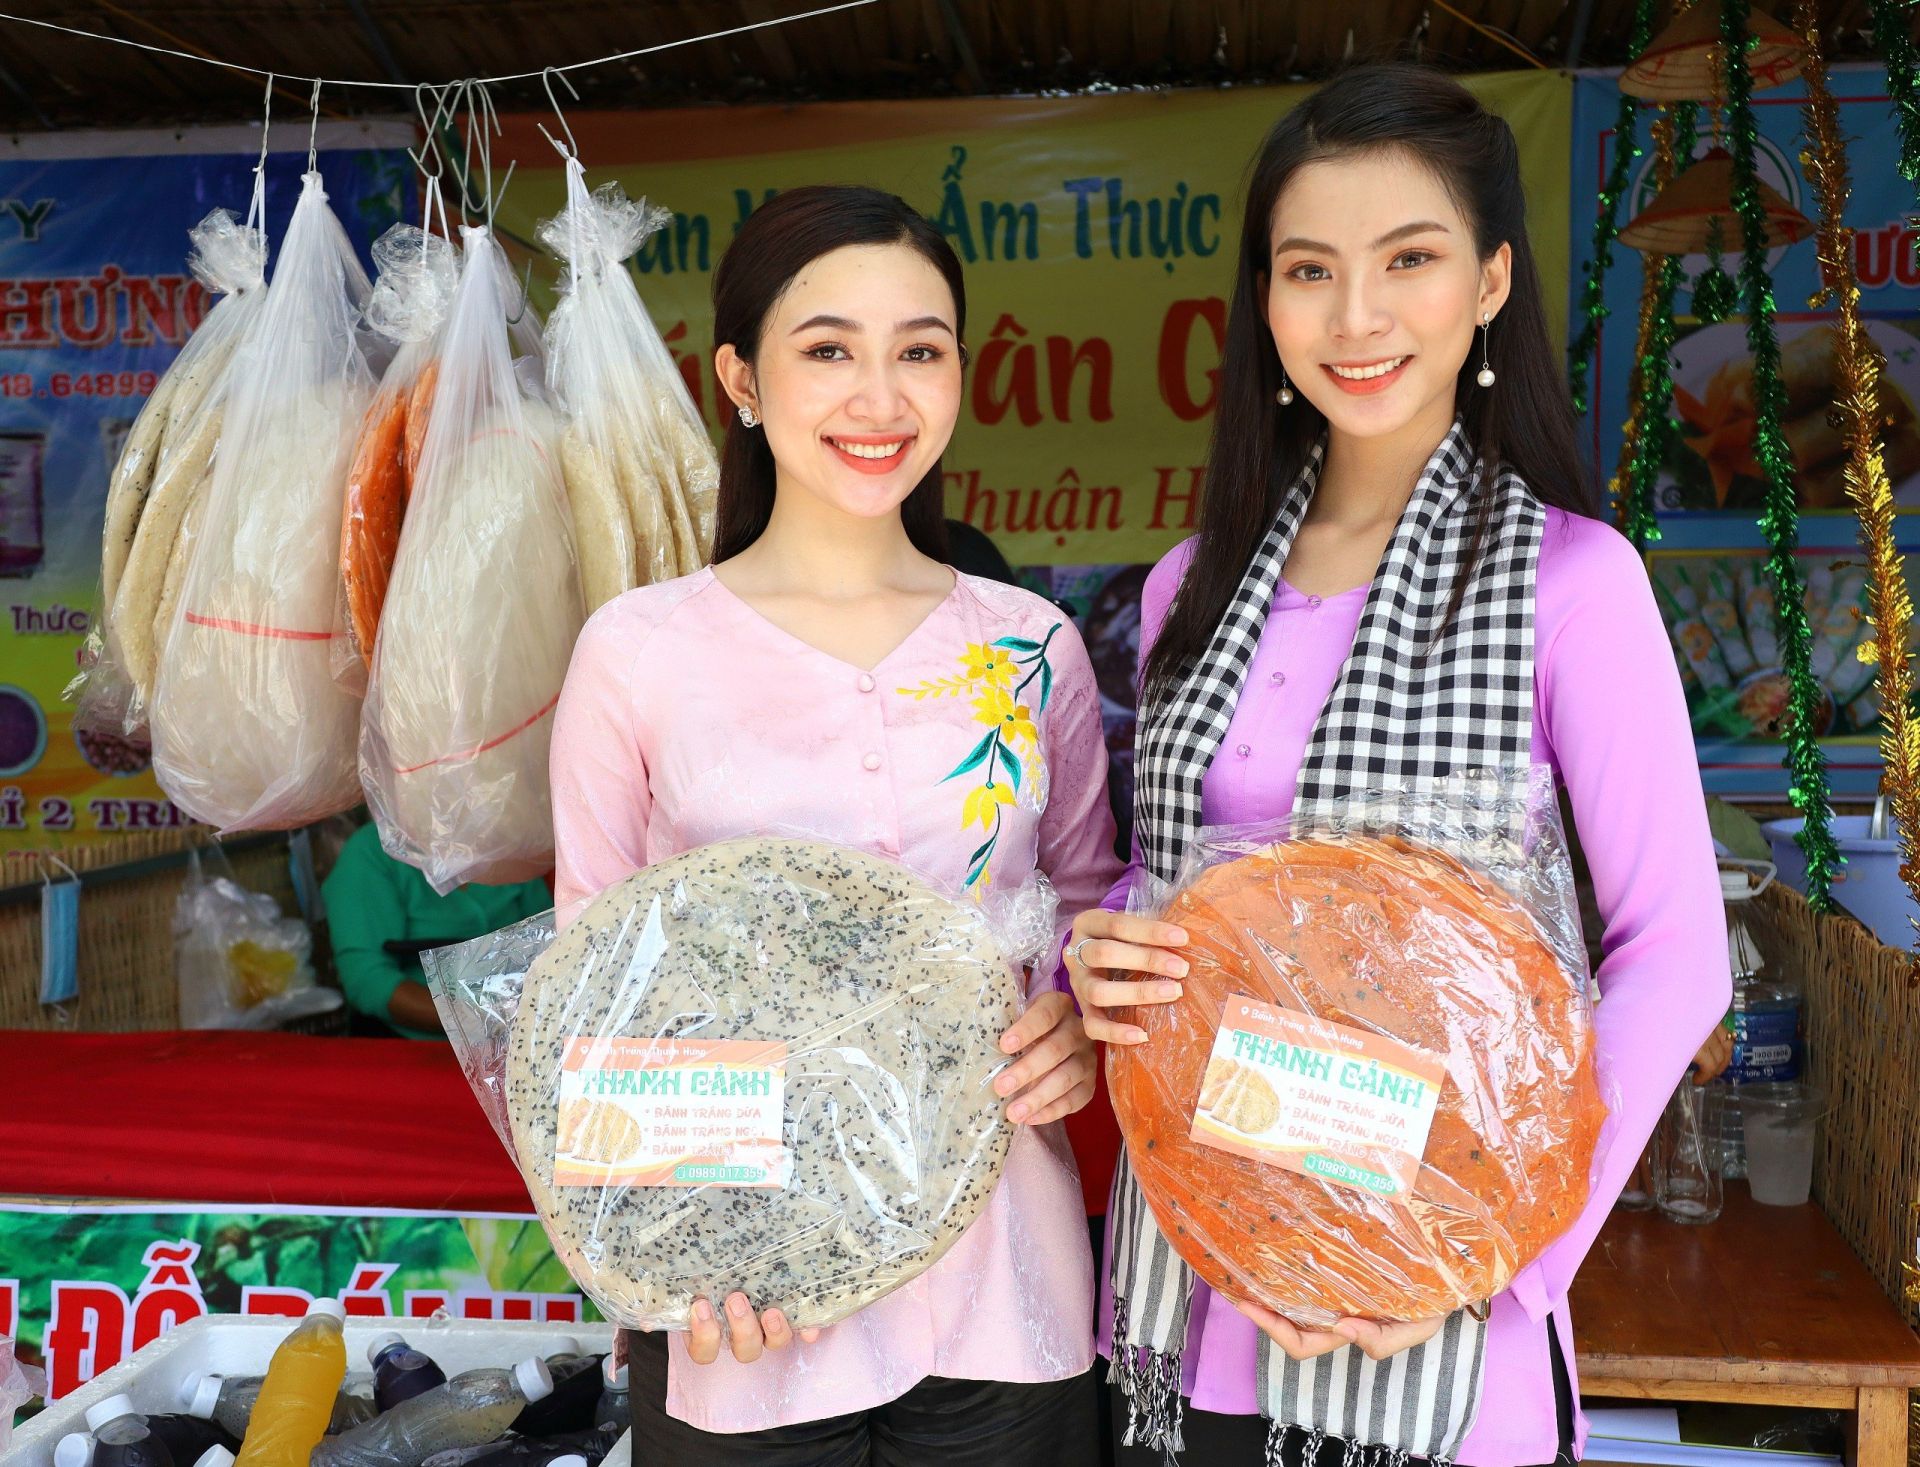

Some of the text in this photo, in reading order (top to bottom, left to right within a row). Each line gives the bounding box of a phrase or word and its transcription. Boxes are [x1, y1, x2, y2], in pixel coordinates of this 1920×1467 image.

[937, 145, 1039, 262] Ẩm
[1064, 176, 1222, 274] Thực
[11, 605, 89, 632] Thức
[41, 799, 72, 829] 2
[578, 1063, 771, 1096] THANH CẢNH
[1232, 1029, 1426, 1108] THANH CẢNH
[654, 1105, 688, 1119] BÁNH
[692, 1105, 732, 1119] TRÁNG
[653, 1123, 687, 1137] BÁNH
[691, 1123, 731, 1137] TRÁNG
[652, 1142, 686, 1156] BÁNH
